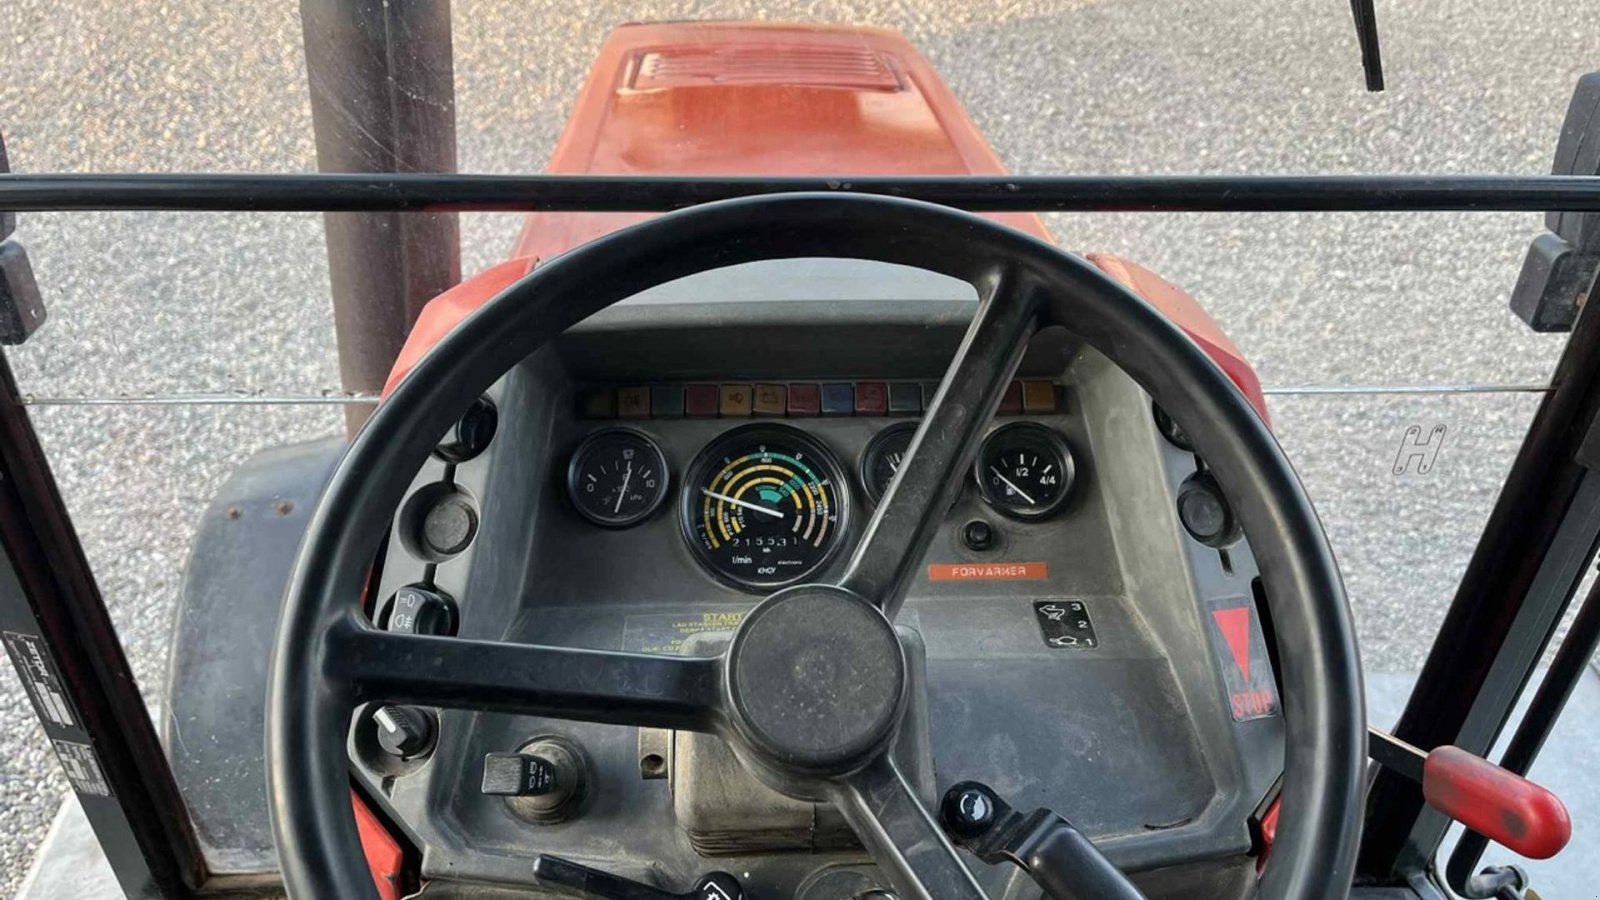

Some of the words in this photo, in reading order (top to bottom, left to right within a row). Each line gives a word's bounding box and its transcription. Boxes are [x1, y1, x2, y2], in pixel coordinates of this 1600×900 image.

[1016, 467, 1029, 477] 1/2
[645, 479, 655, 488] 10
[1039, 475, 1056, 485] 4/4
[586, 483, 594, 493] 0
[952, 566, 1026, 577] FORVARMER
[1071, 603, 1082, 611] 3
[1077, 619, 1088, 629] 2
[1085, 638, 1093, 646] 1
[1230, 687, 1272, 719] STOP
